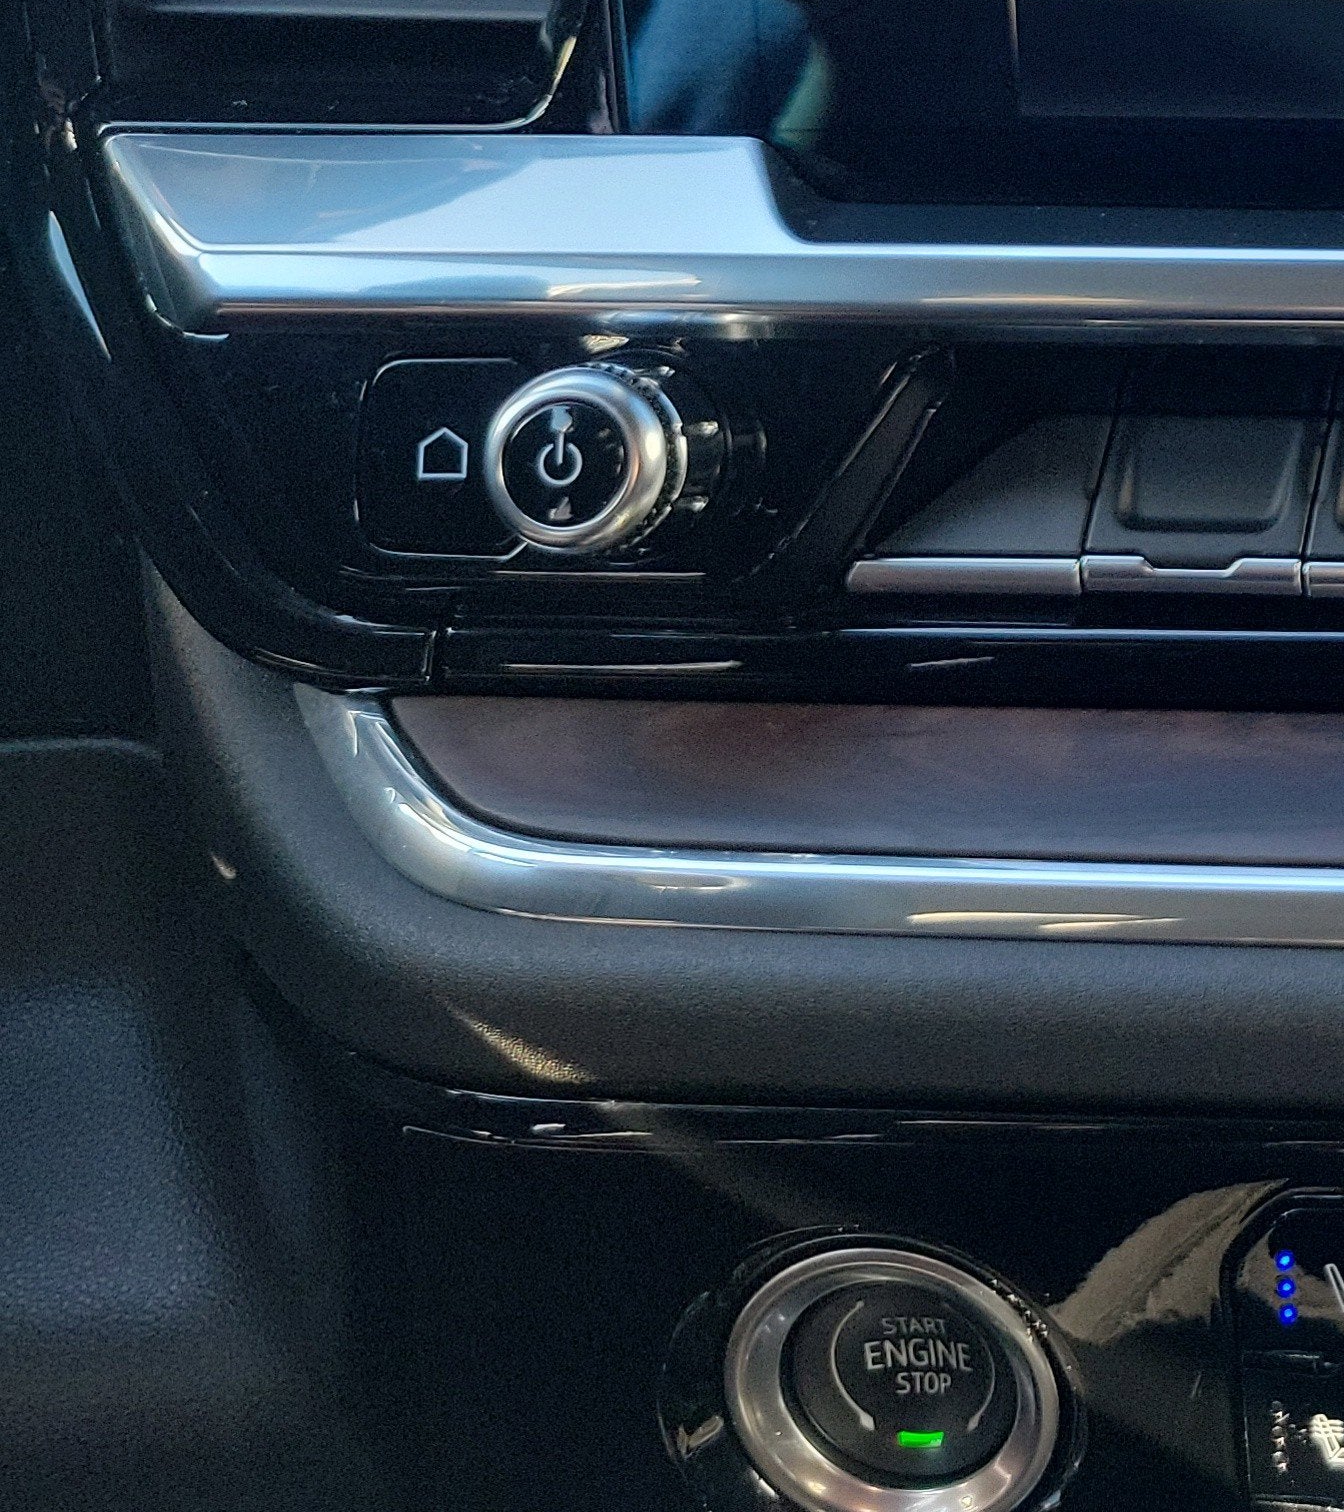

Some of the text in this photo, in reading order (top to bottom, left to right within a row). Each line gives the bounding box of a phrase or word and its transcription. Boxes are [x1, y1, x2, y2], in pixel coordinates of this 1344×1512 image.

[881, 1316, 947, 1335] START
[863, 1338, 974, 1371] ENGINE
[895, 1372, 952, 1394] STOP
